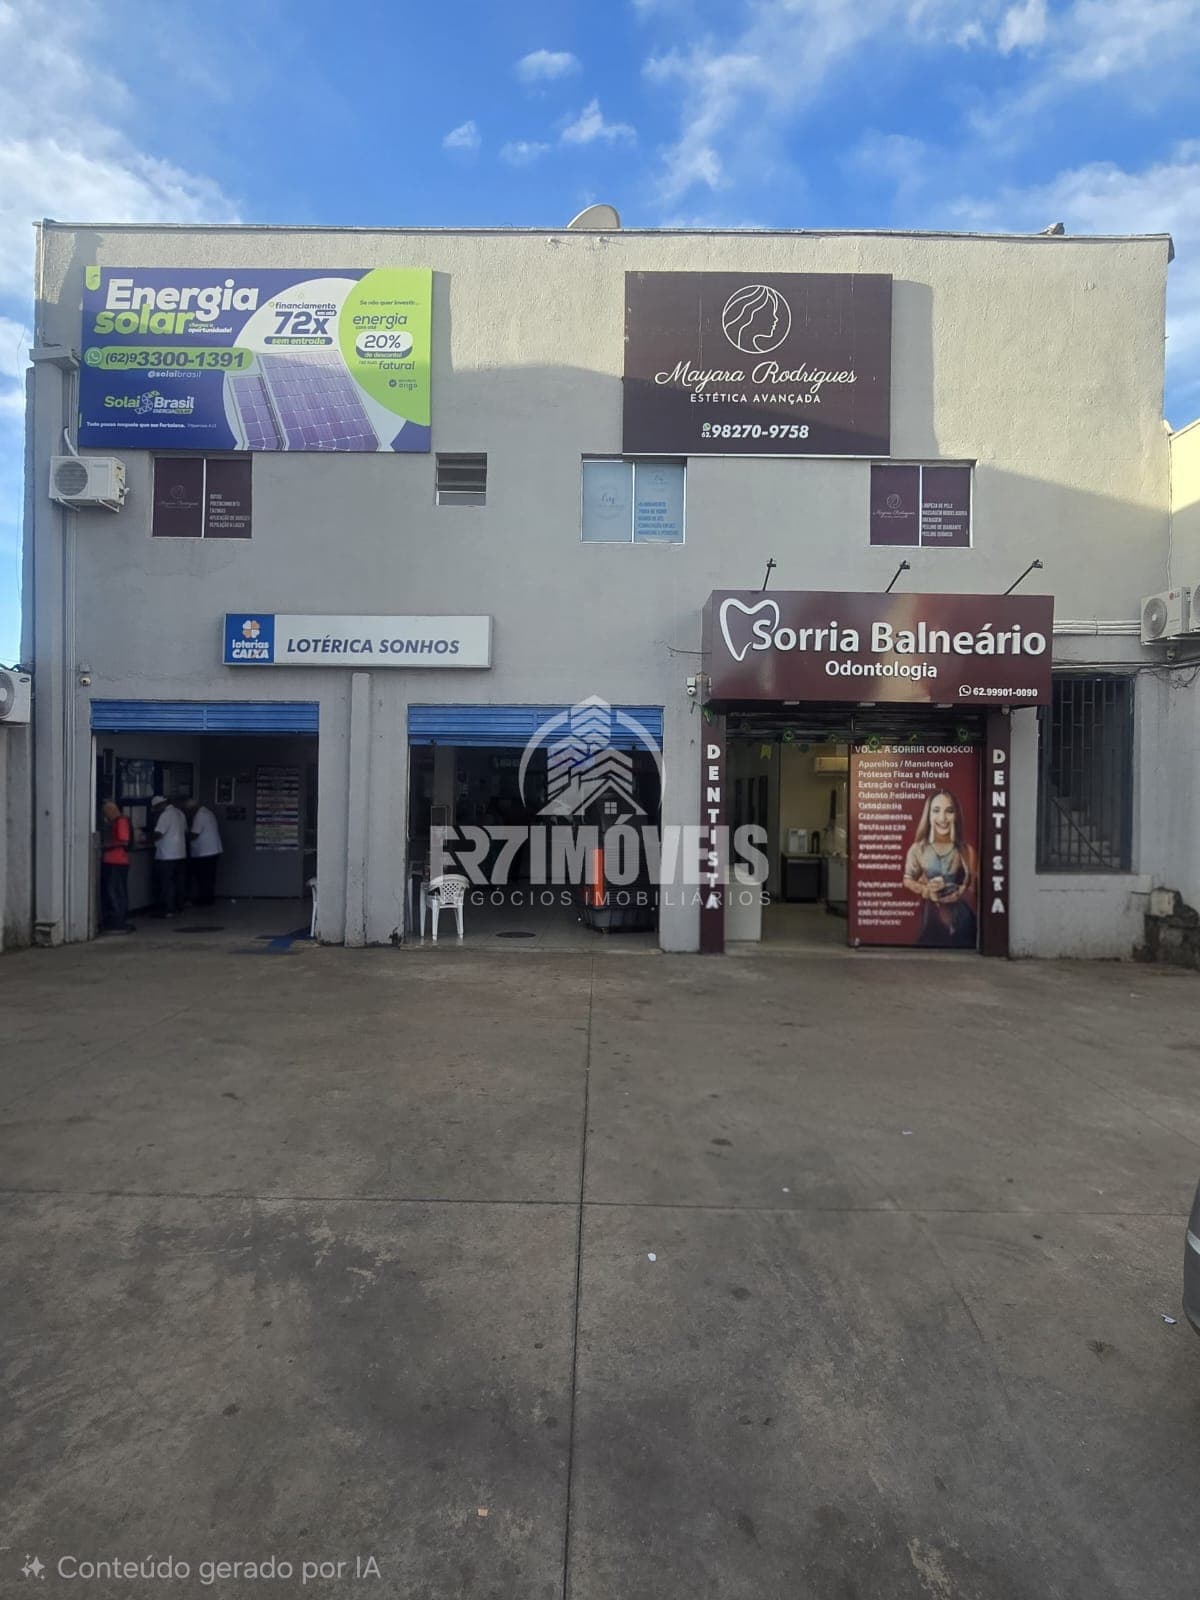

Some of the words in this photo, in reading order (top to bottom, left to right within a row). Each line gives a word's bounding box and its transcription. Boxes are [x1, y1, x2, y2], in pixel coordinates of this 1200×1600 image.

[105, 278, 259, 322] Energia
[275, 301, 336, 310] financiamento
[94, 304, 195, 335] solar
[273, 311, 330, 335] 72x
[352, 312, 408, 329] energia
[291, 337, 326, 345] entrada
[364, 334, 401, 349] 20%
[655, 360, 745, 393] Mayara
[751, 360, 858, 394] Rodrigues
[104, 395, 140, 408] Solai
[154, 396, 195, 408] Brasil
[690, 391, 747, 403] ESTÉTICA
[753, 394, 821, 405] AVANÇADA
[232, 639, 269, 648] loterias
[287, 635, 373, 653] LOTÉRICA
[379, 638, 460, 654] SONHOS
[752, 618, 859, 652] Sorria
[871, 621, 1046, 656] Balneário
[232, 648, 269, 659] CAIXA
[825, 660, 937, 681] Odontologia
[892, 745, 925, 754] SORRIR
[926, 745, 974, 754] CONOSCO!
[858, 760, 898, 769] Aparelhos
[904, 760, 954, 769] Manutenção
[858, 770, 892, 778] Próteses
[921, 771, 950, 779] Móveis
[858, 781, 892, 789] Extração
[706, 744, 721, 909] DENTISTA
[992, 749, 1006, 914] DENTISTA
